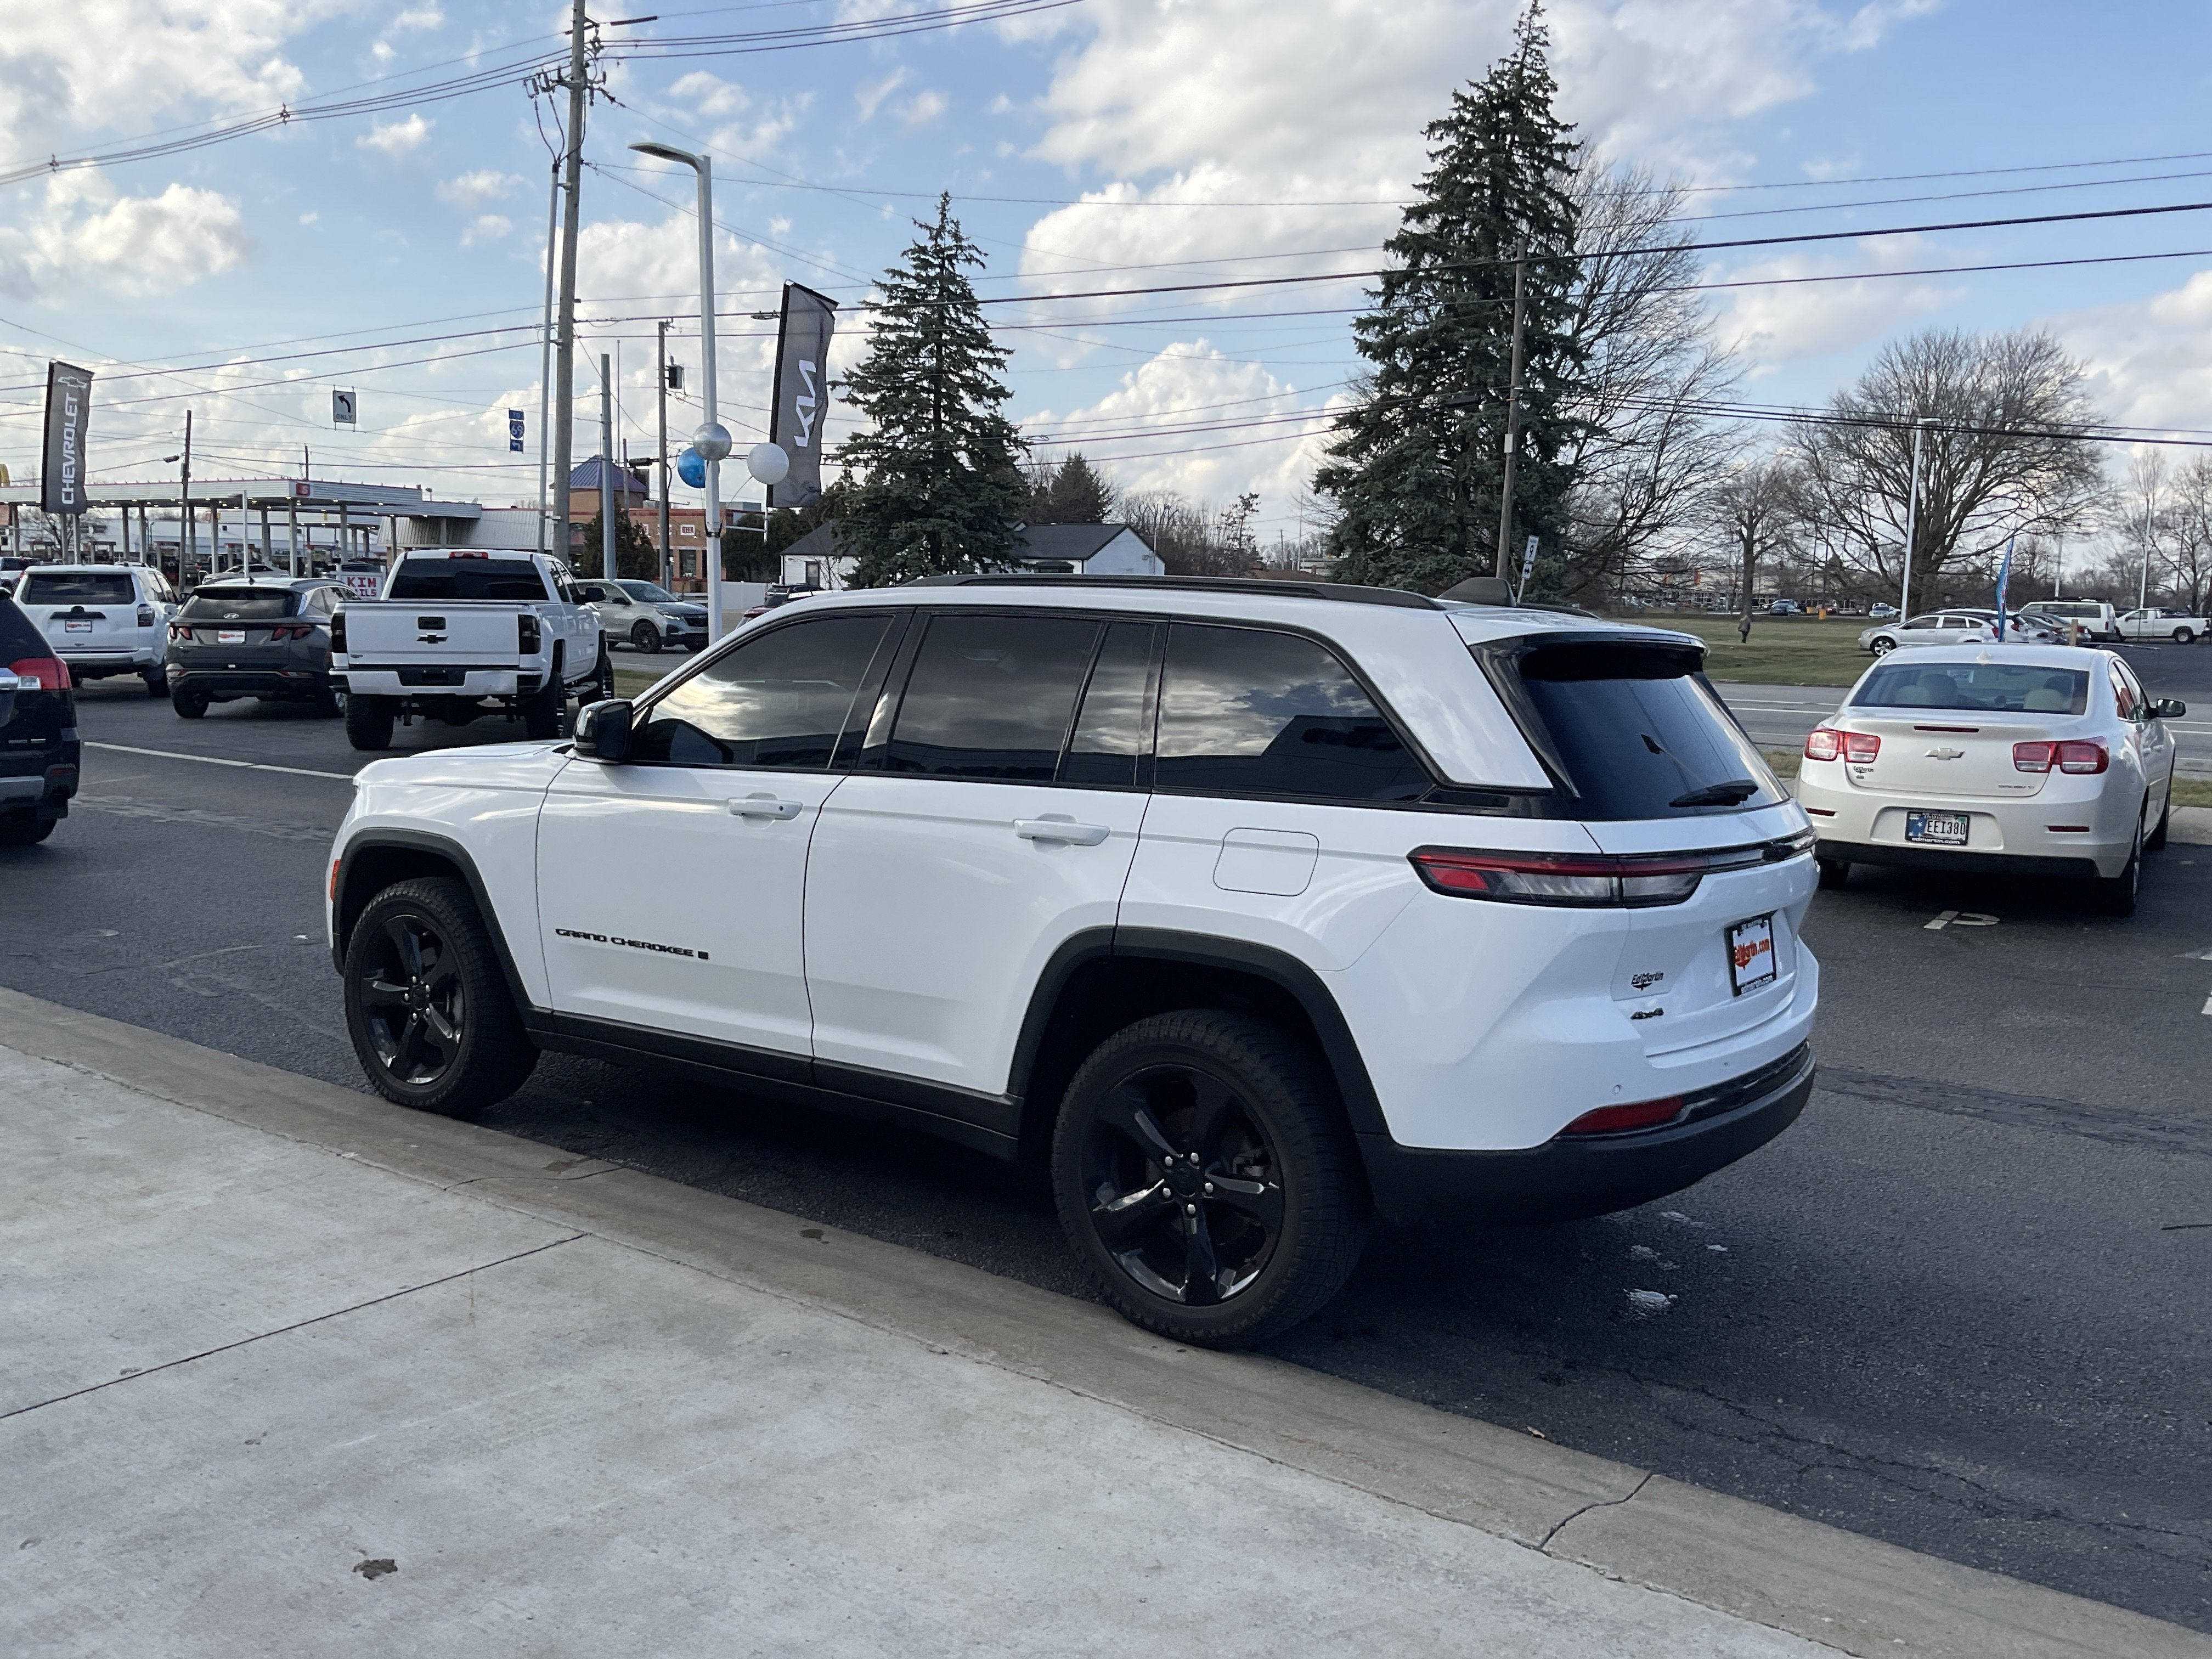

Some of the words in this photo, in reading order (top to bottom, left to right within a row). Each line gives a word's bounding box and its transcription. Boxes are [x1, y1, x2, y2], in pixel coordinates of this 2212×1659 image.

[511, 424, 523, 436] 69
[61, 392, 78, 505] CHEVROLET
[1529, 545, 1534, 558] 9
[347, 577, 377, 588] KIM
[555, 928, 607, 943] GRAND
[611, 936, 694, 957] CHEROKEE
